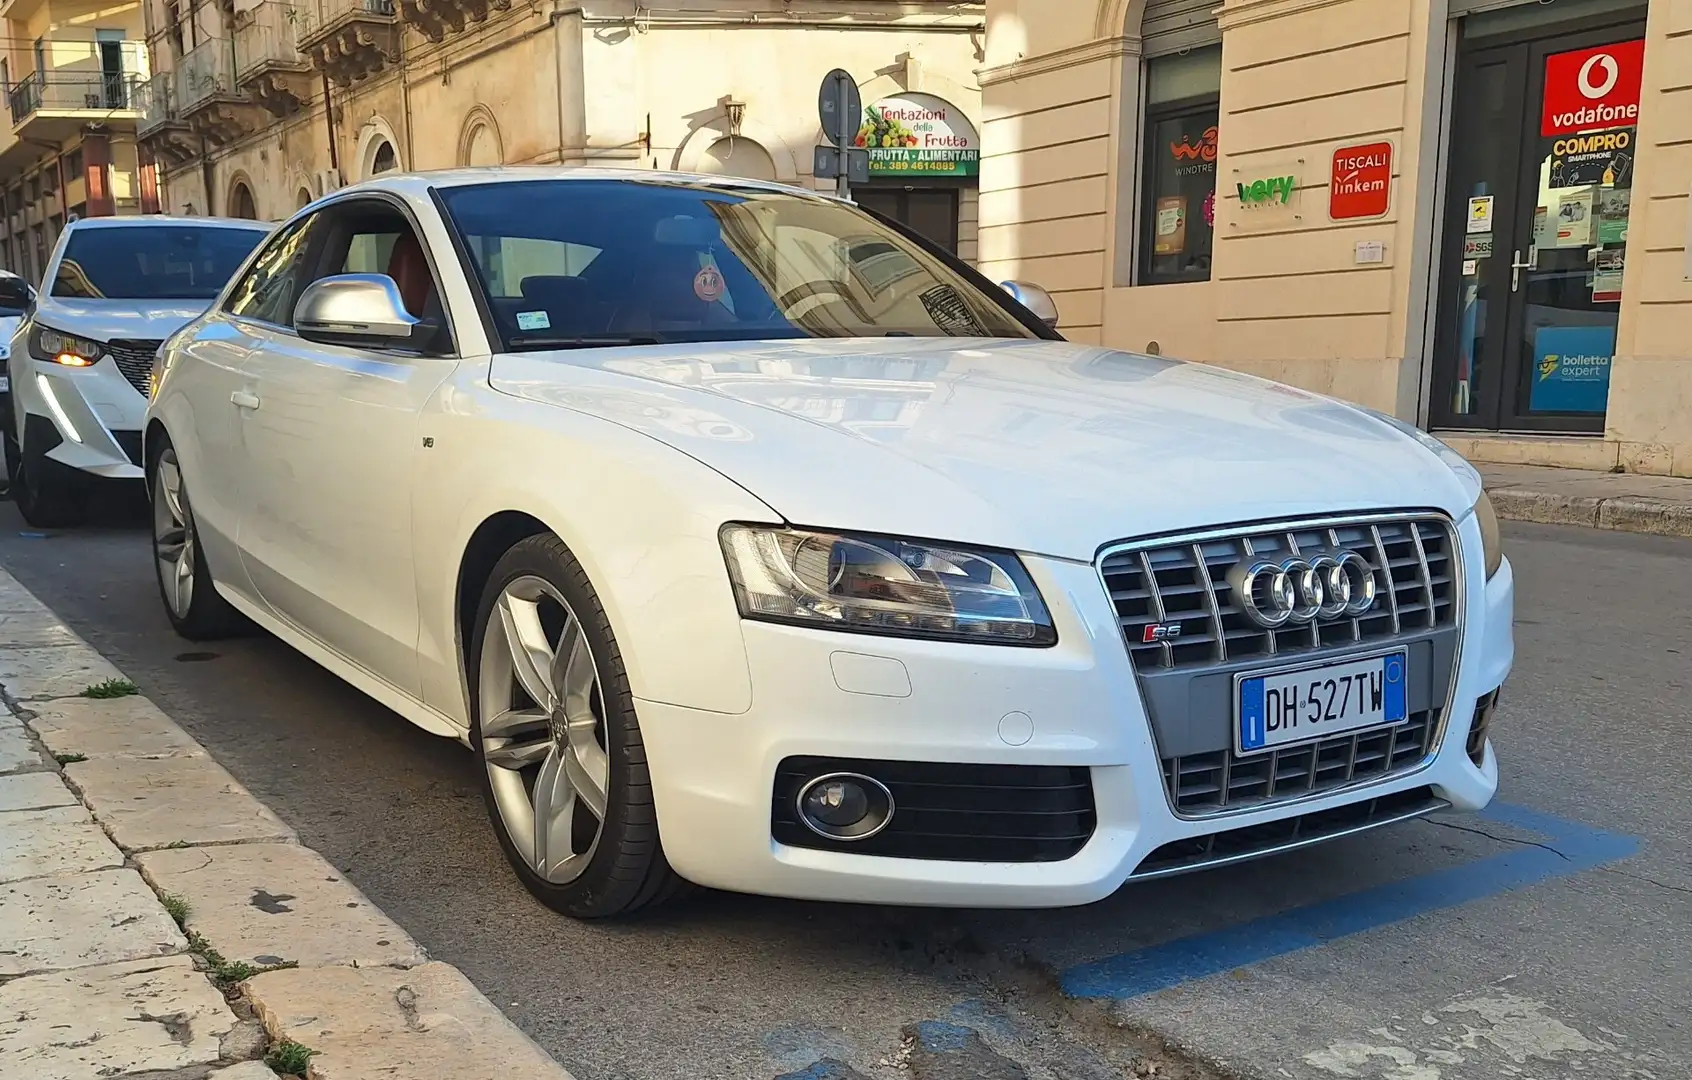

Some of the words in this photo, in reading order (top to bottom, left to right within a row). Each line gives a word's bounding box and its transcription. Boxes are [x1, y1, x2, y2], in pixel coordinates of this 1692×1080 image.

[879, 106, 946, 121] Tentazioni
[1552, 103, 1638, 128] vodafone
[913, 123, 934, 132] della
[925, 133, 968, 148] Frutta
[1553, 132, 1630, 156] COMPRO
[918, 150, 978, 161] ALIMENTARI
[1567, 151, 1612, 163] SMARTPHONE
[889, 161, 908, 170] 389
[1336, 153, 1386, 172] TISCALI
[1175, 163, 1213, 176] WINDTRE
[1236, 175, 1294, 204] very
[1334, 174, 1385, 195] linkem
[1475, 242, 1492, 252] SGS
[1562, 354, 1609, 366] bolletta
[1561, 366, 1600, 377] expert
[1151, 625, 1181, 638] S5
[1266, 685, 1298, 732] DH
[1308, 670, 1383, 724] 527TW
